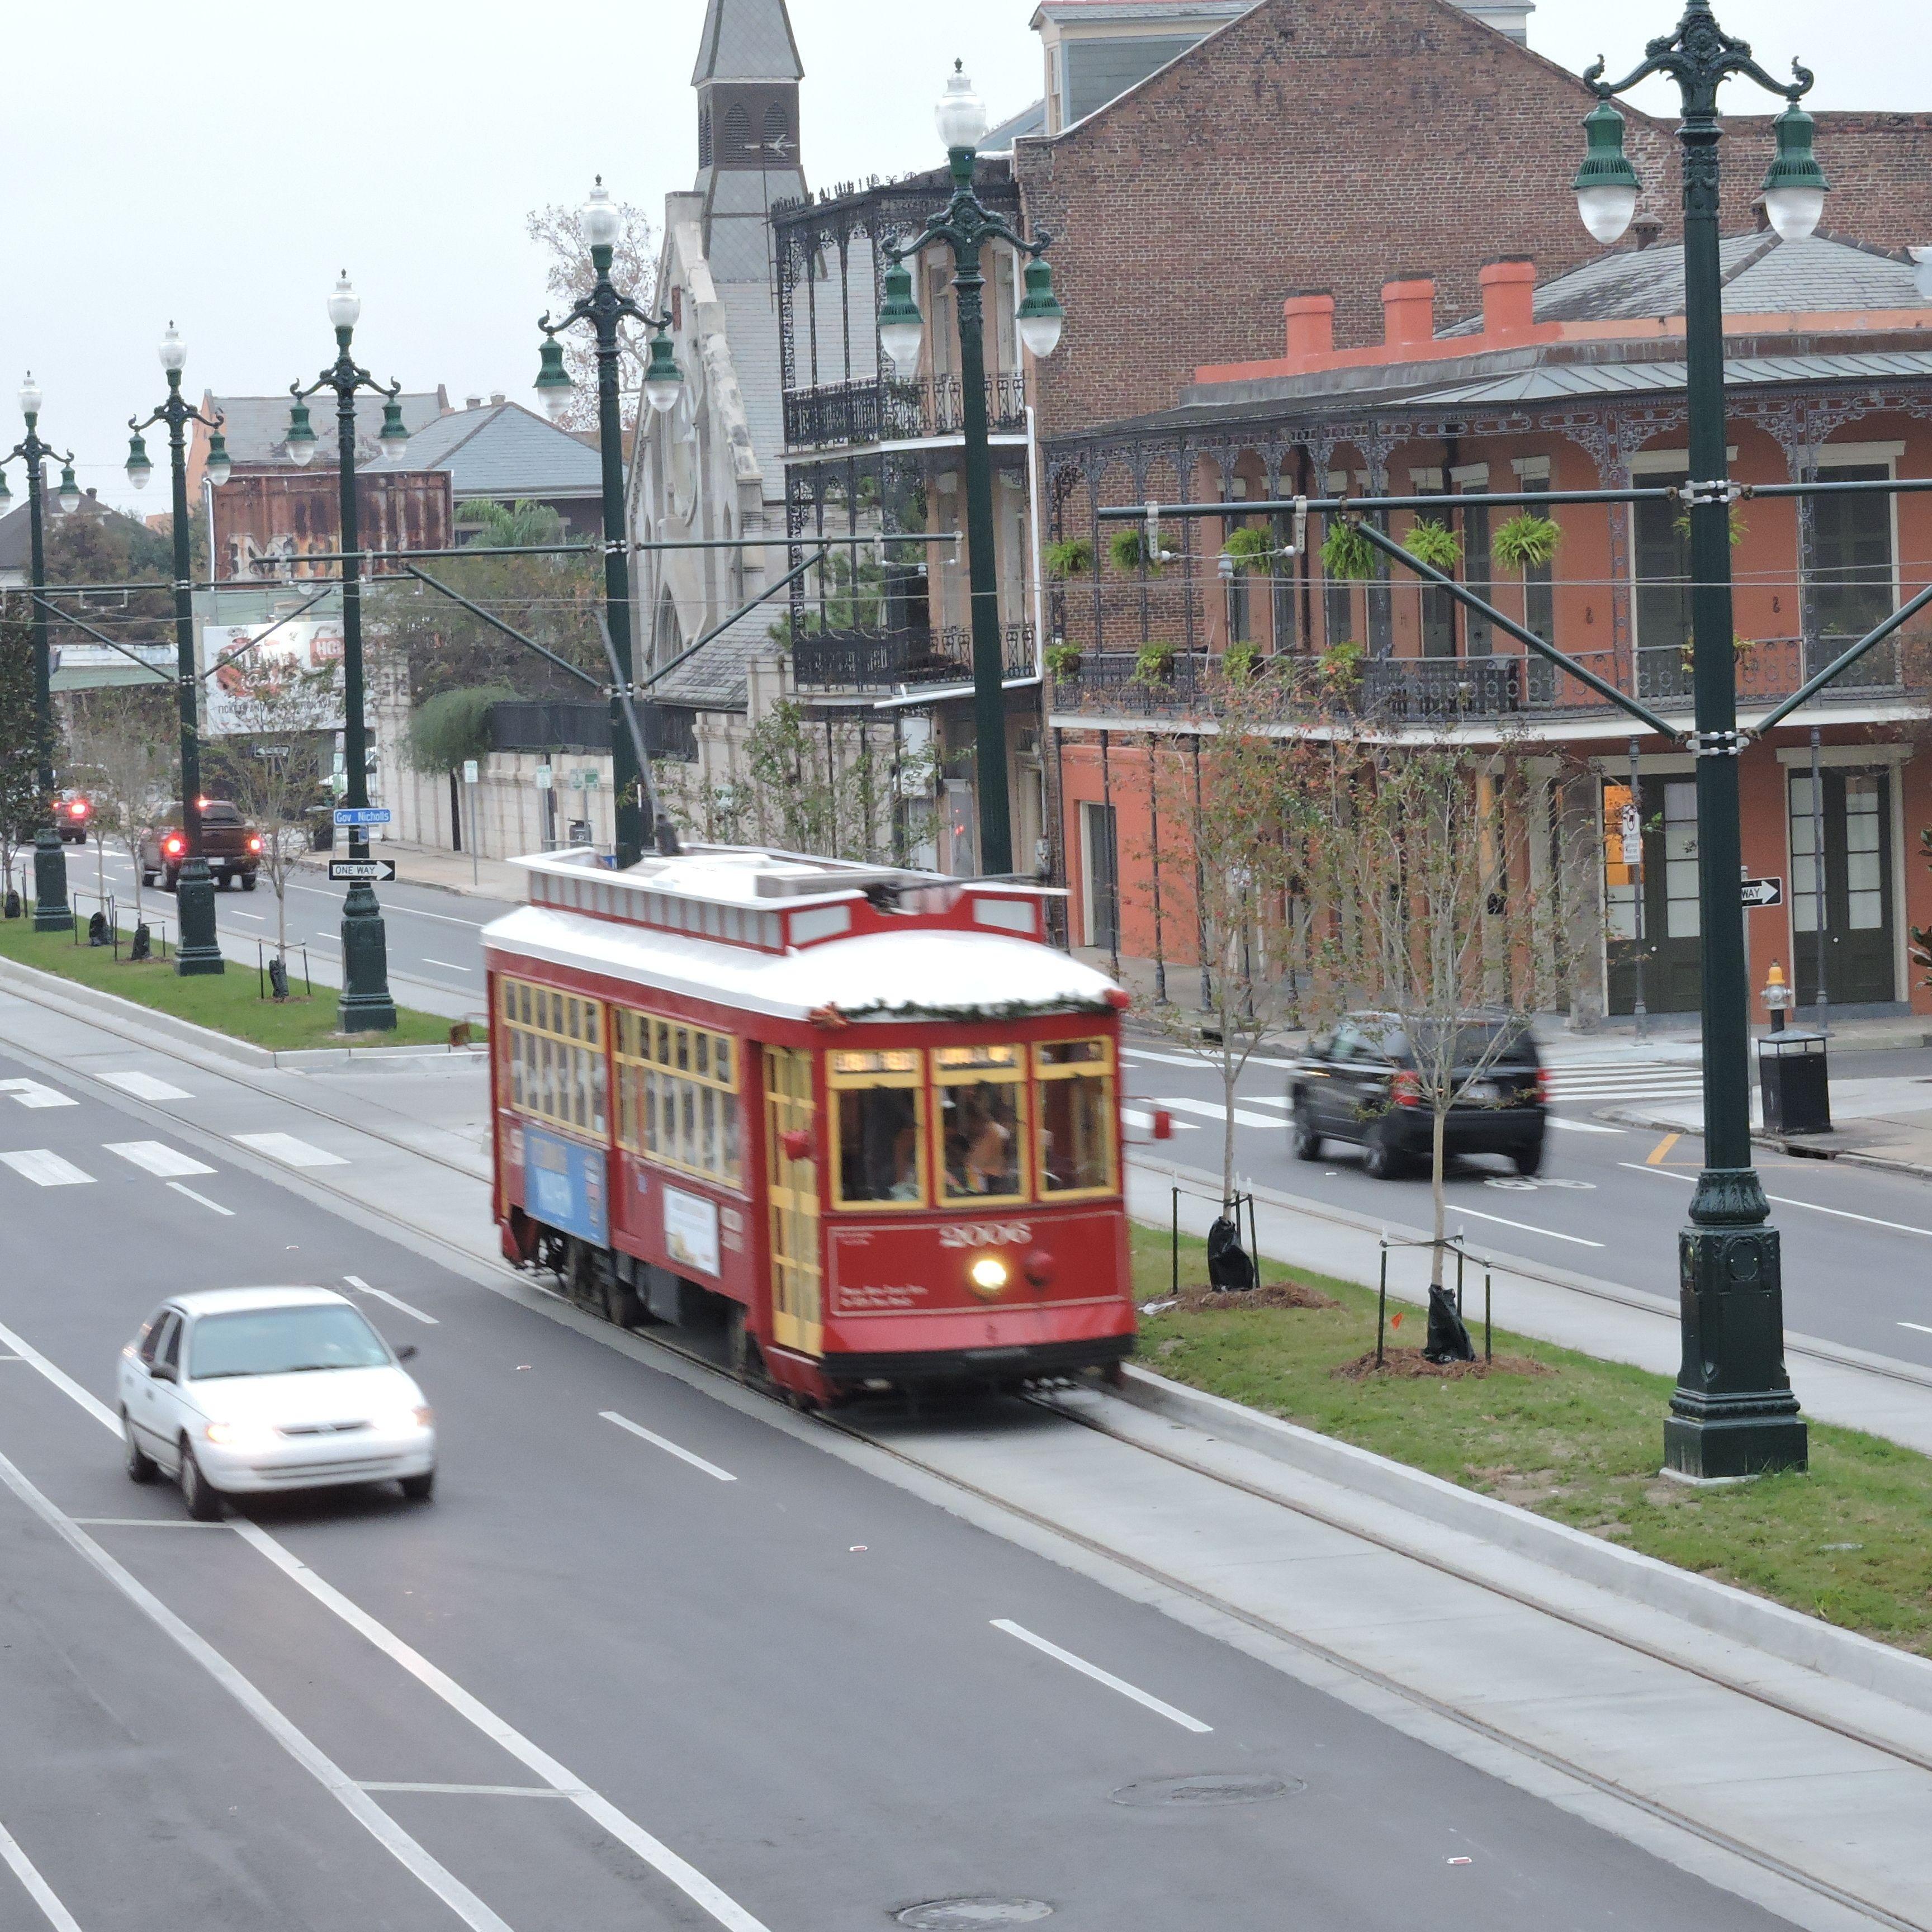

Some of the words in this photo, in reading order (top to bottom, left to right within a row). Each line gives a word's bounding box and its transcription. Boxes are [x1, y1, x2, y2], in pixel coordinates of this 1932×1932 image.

[337, 812, 352, 822] Gov
[358, 811, 389, 821] Nicholls
[335, 866, 353, 874] ONE
[1741, 887, 1760, 898] WAY
